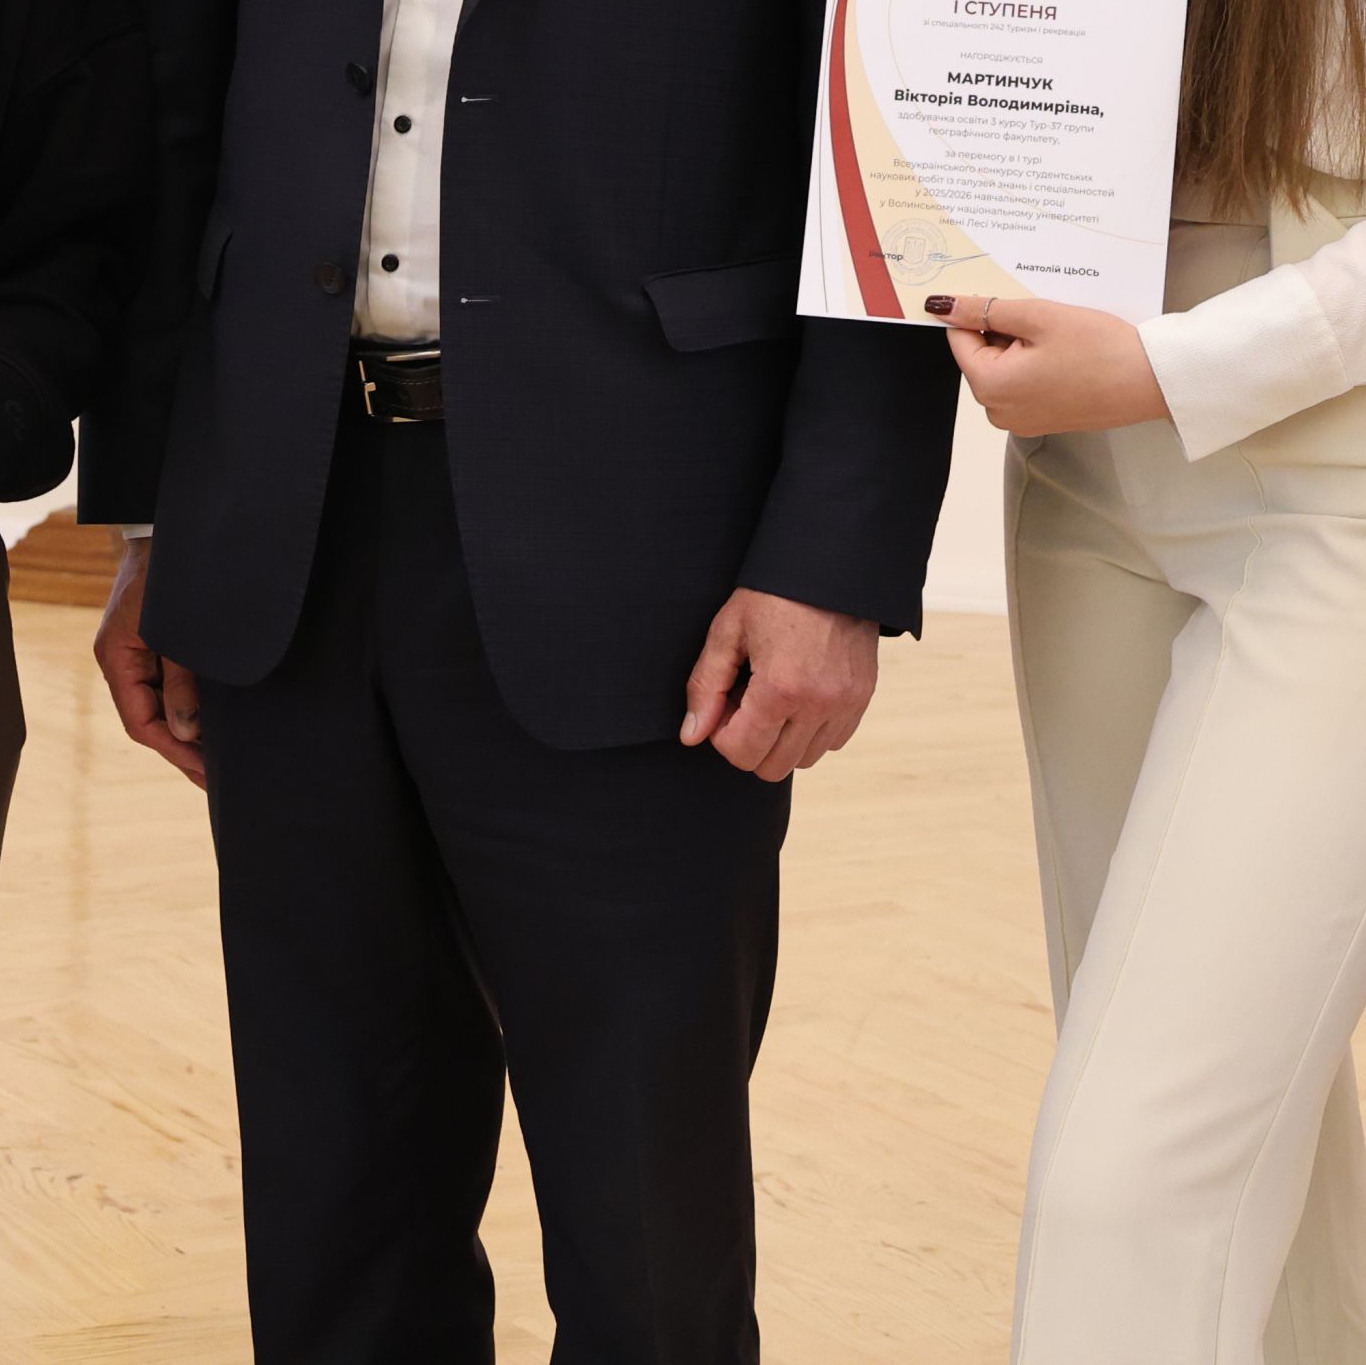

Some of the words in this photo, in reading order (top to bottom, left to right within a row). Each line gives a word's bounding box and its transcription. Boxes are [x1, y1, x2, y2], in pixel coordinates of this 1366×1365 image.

[963, 0, 1057, 21] СТУПЕНЯ
[959, 51, 1043, 65] НАГОРОДЖУЄТЬСЯ
[946, 70, 1054, 91] МАРТИНЧУК
[892, 87, 963, 107] Вікторія
[966, 93, 1104, 118] Володимирівна,
[896, 110, 955, 123] здобувачка
[956, 114, 989, 125] освіти
[998, 118, 1028, 130] курсу
[1028, 119, 1063, 131] Тур-37
[1063, 123, 1094, 134] групи
[927, 127, 1001, 139] географічного
[957, 150, 1007, 164] перемогу
[1021, 154, 1042, 166] турі
[892, 158, 976, 173] Всеукраїнського
[977, 166, 1025, 178] конкурсу
[1025, 169, 1093, 182] студентських
[938, 215, 965, 226] імені
[965, 217, 989, 228] Лесі
[989, 219, 1036, 232] Українки
[1013, 262, 1061, 274] Анатолій
[1062, 265, 1100, 277] ЦЬОСЬ
